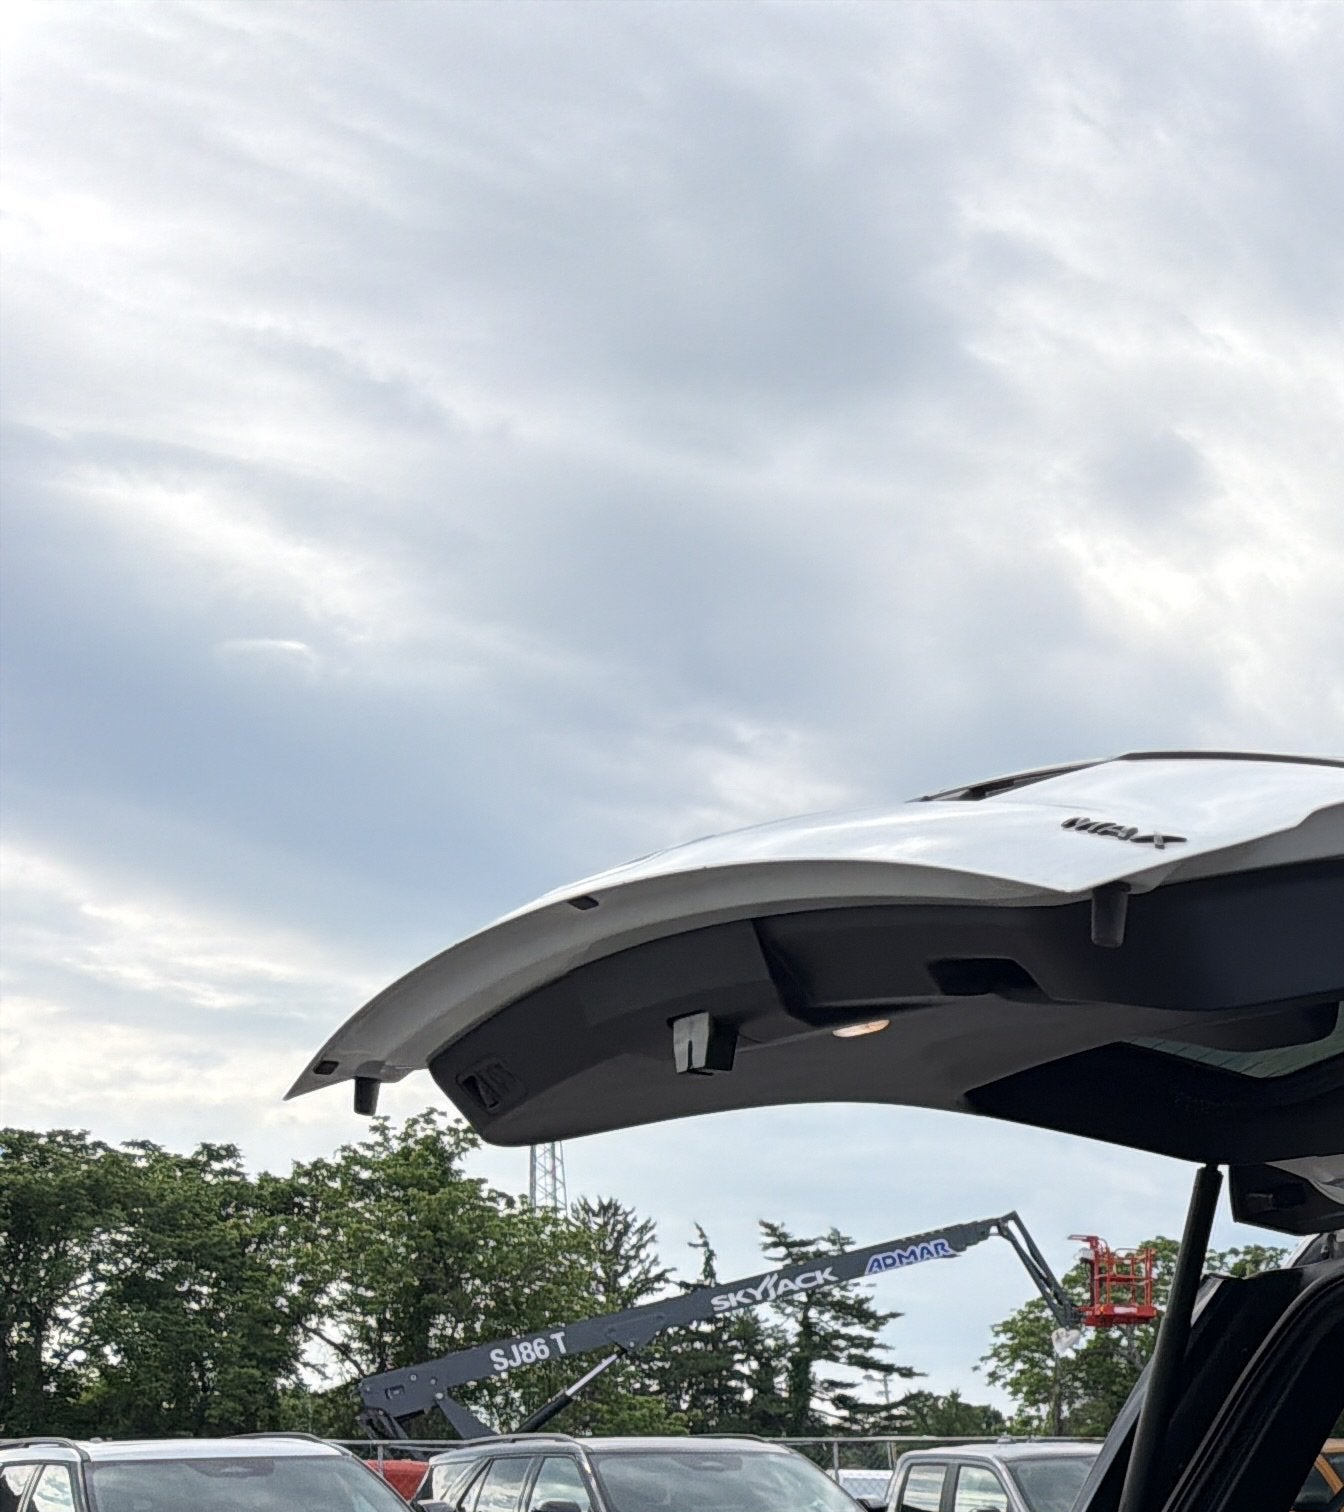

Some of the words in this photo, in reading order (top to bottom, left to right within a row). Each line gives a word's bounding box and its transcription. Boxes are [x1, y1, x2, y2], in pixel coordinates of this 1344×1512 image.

[1060, 816, 1187, 850] MAX
[865, 1238, 953, 1276] ADMAR
[710, 1266, 839, 1312] SKYJACK
[489, 1337, 551, 1371] SJ86
[549, 1331, 567, 1354] T
